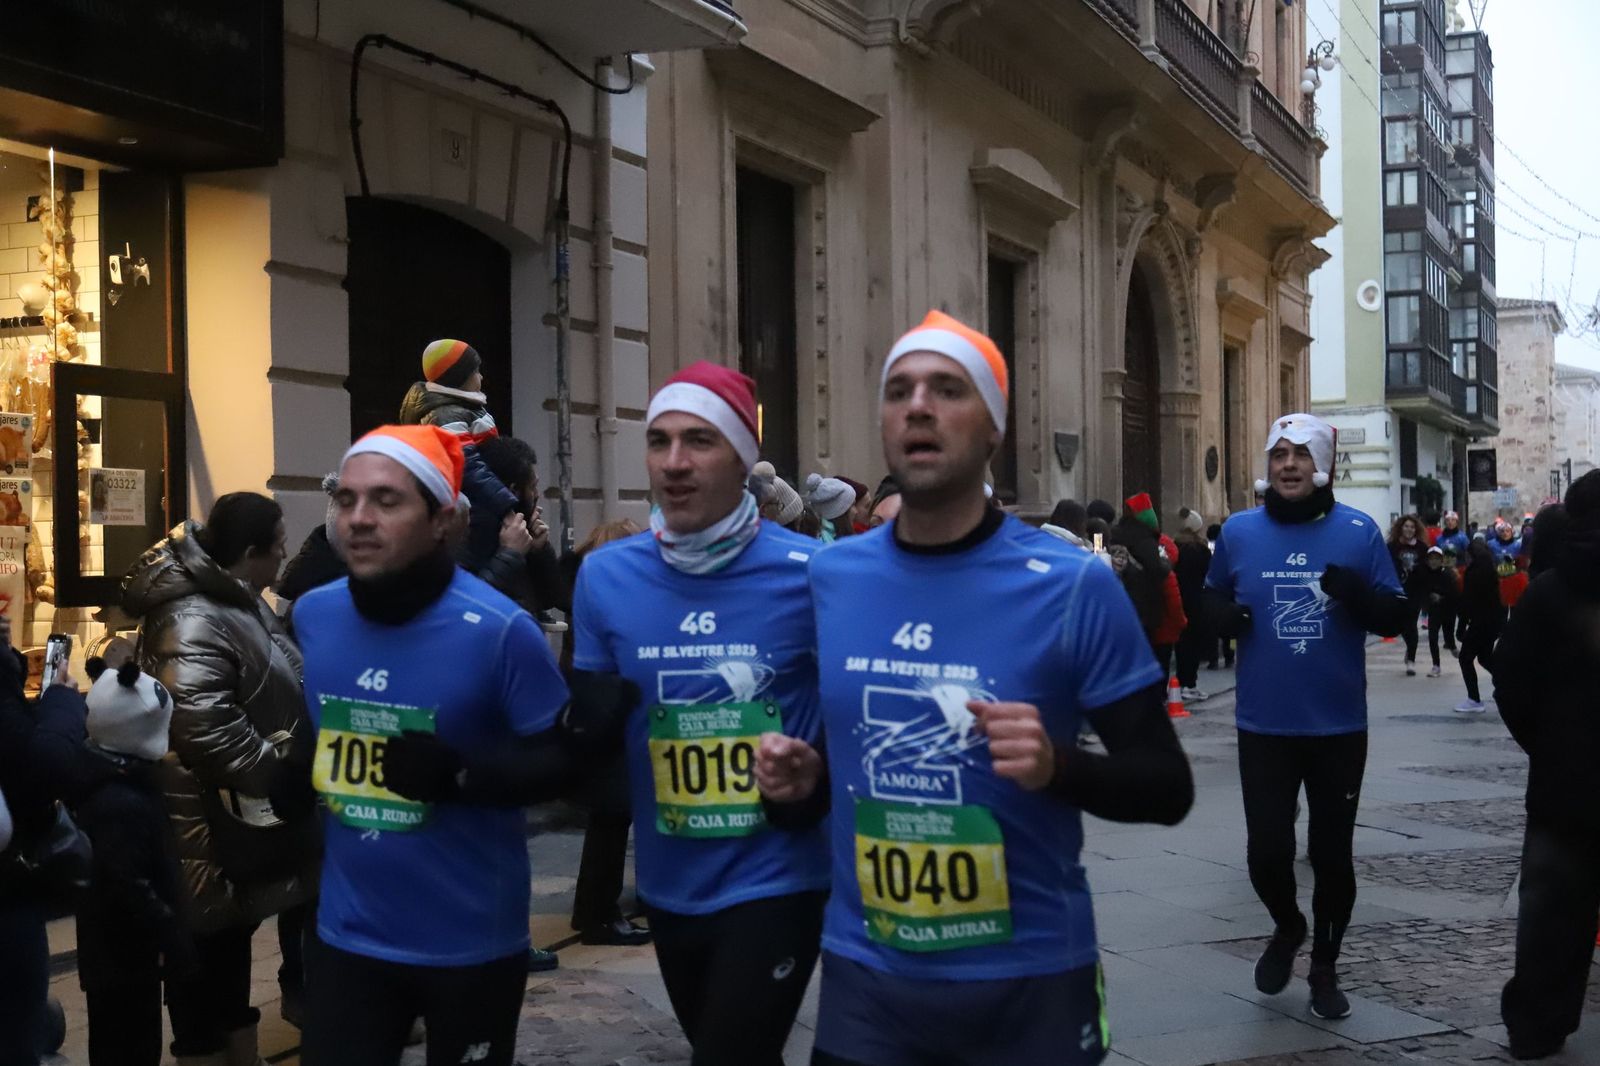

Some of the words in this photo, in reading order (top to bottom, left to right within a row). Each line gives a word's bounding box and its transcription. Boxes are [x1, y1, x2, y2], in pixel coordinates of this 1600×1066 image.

[107, 478, 136, 489] 03322
[1285, 553, 1307, 566] 46
[679, 611, 717, 635] 46
[891, 622, 933, 651] 46
[637, 646, 661, 660] SAN
[662, 645, 726, 659] SILVESTRE
[845, 656, 869, 672] SAN
[871, 658, 941, 678] SILVESTRE
[356, 668, 390, 692] 46
[327, 735, 388, 789] 105
[662, 742, 757, 795] 1019
[877, 771, 945, 792] AMORA
[344, 804, 378, 820] CAJA
[687, 814, 725, 829] CAJA
[863, 844, 979, 906] 1040
[897, 924, 939, 942] CAJA
[941, 919, 1004, 940] RURAL
